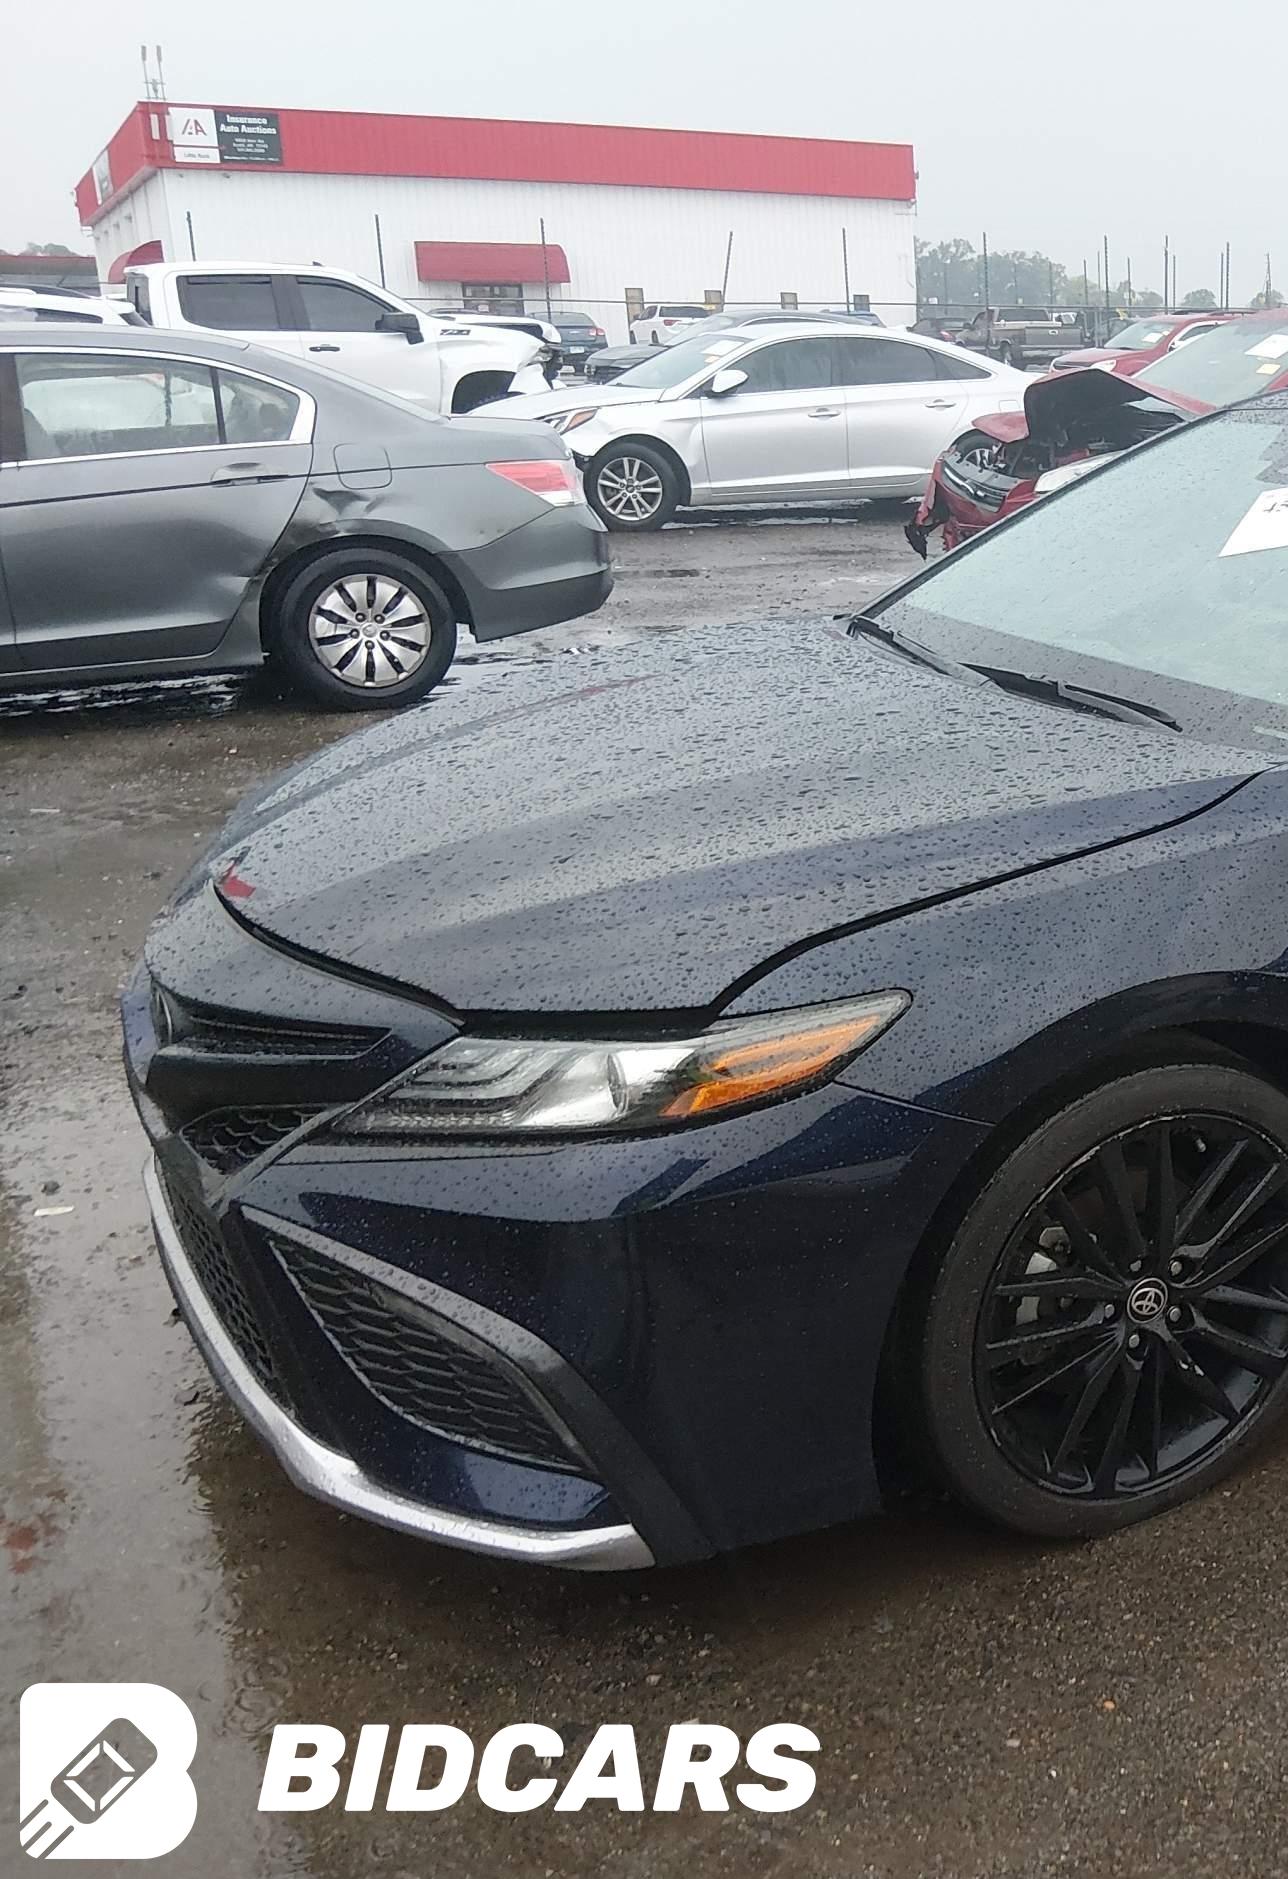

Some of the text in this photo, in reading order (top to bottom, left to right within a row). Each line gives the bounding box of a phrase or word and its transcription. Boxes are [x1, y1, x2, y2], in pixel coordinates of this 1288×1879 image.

[226, 114, 268, 125] Insurance
[219, 123, 277, 135] Auto Auctions
